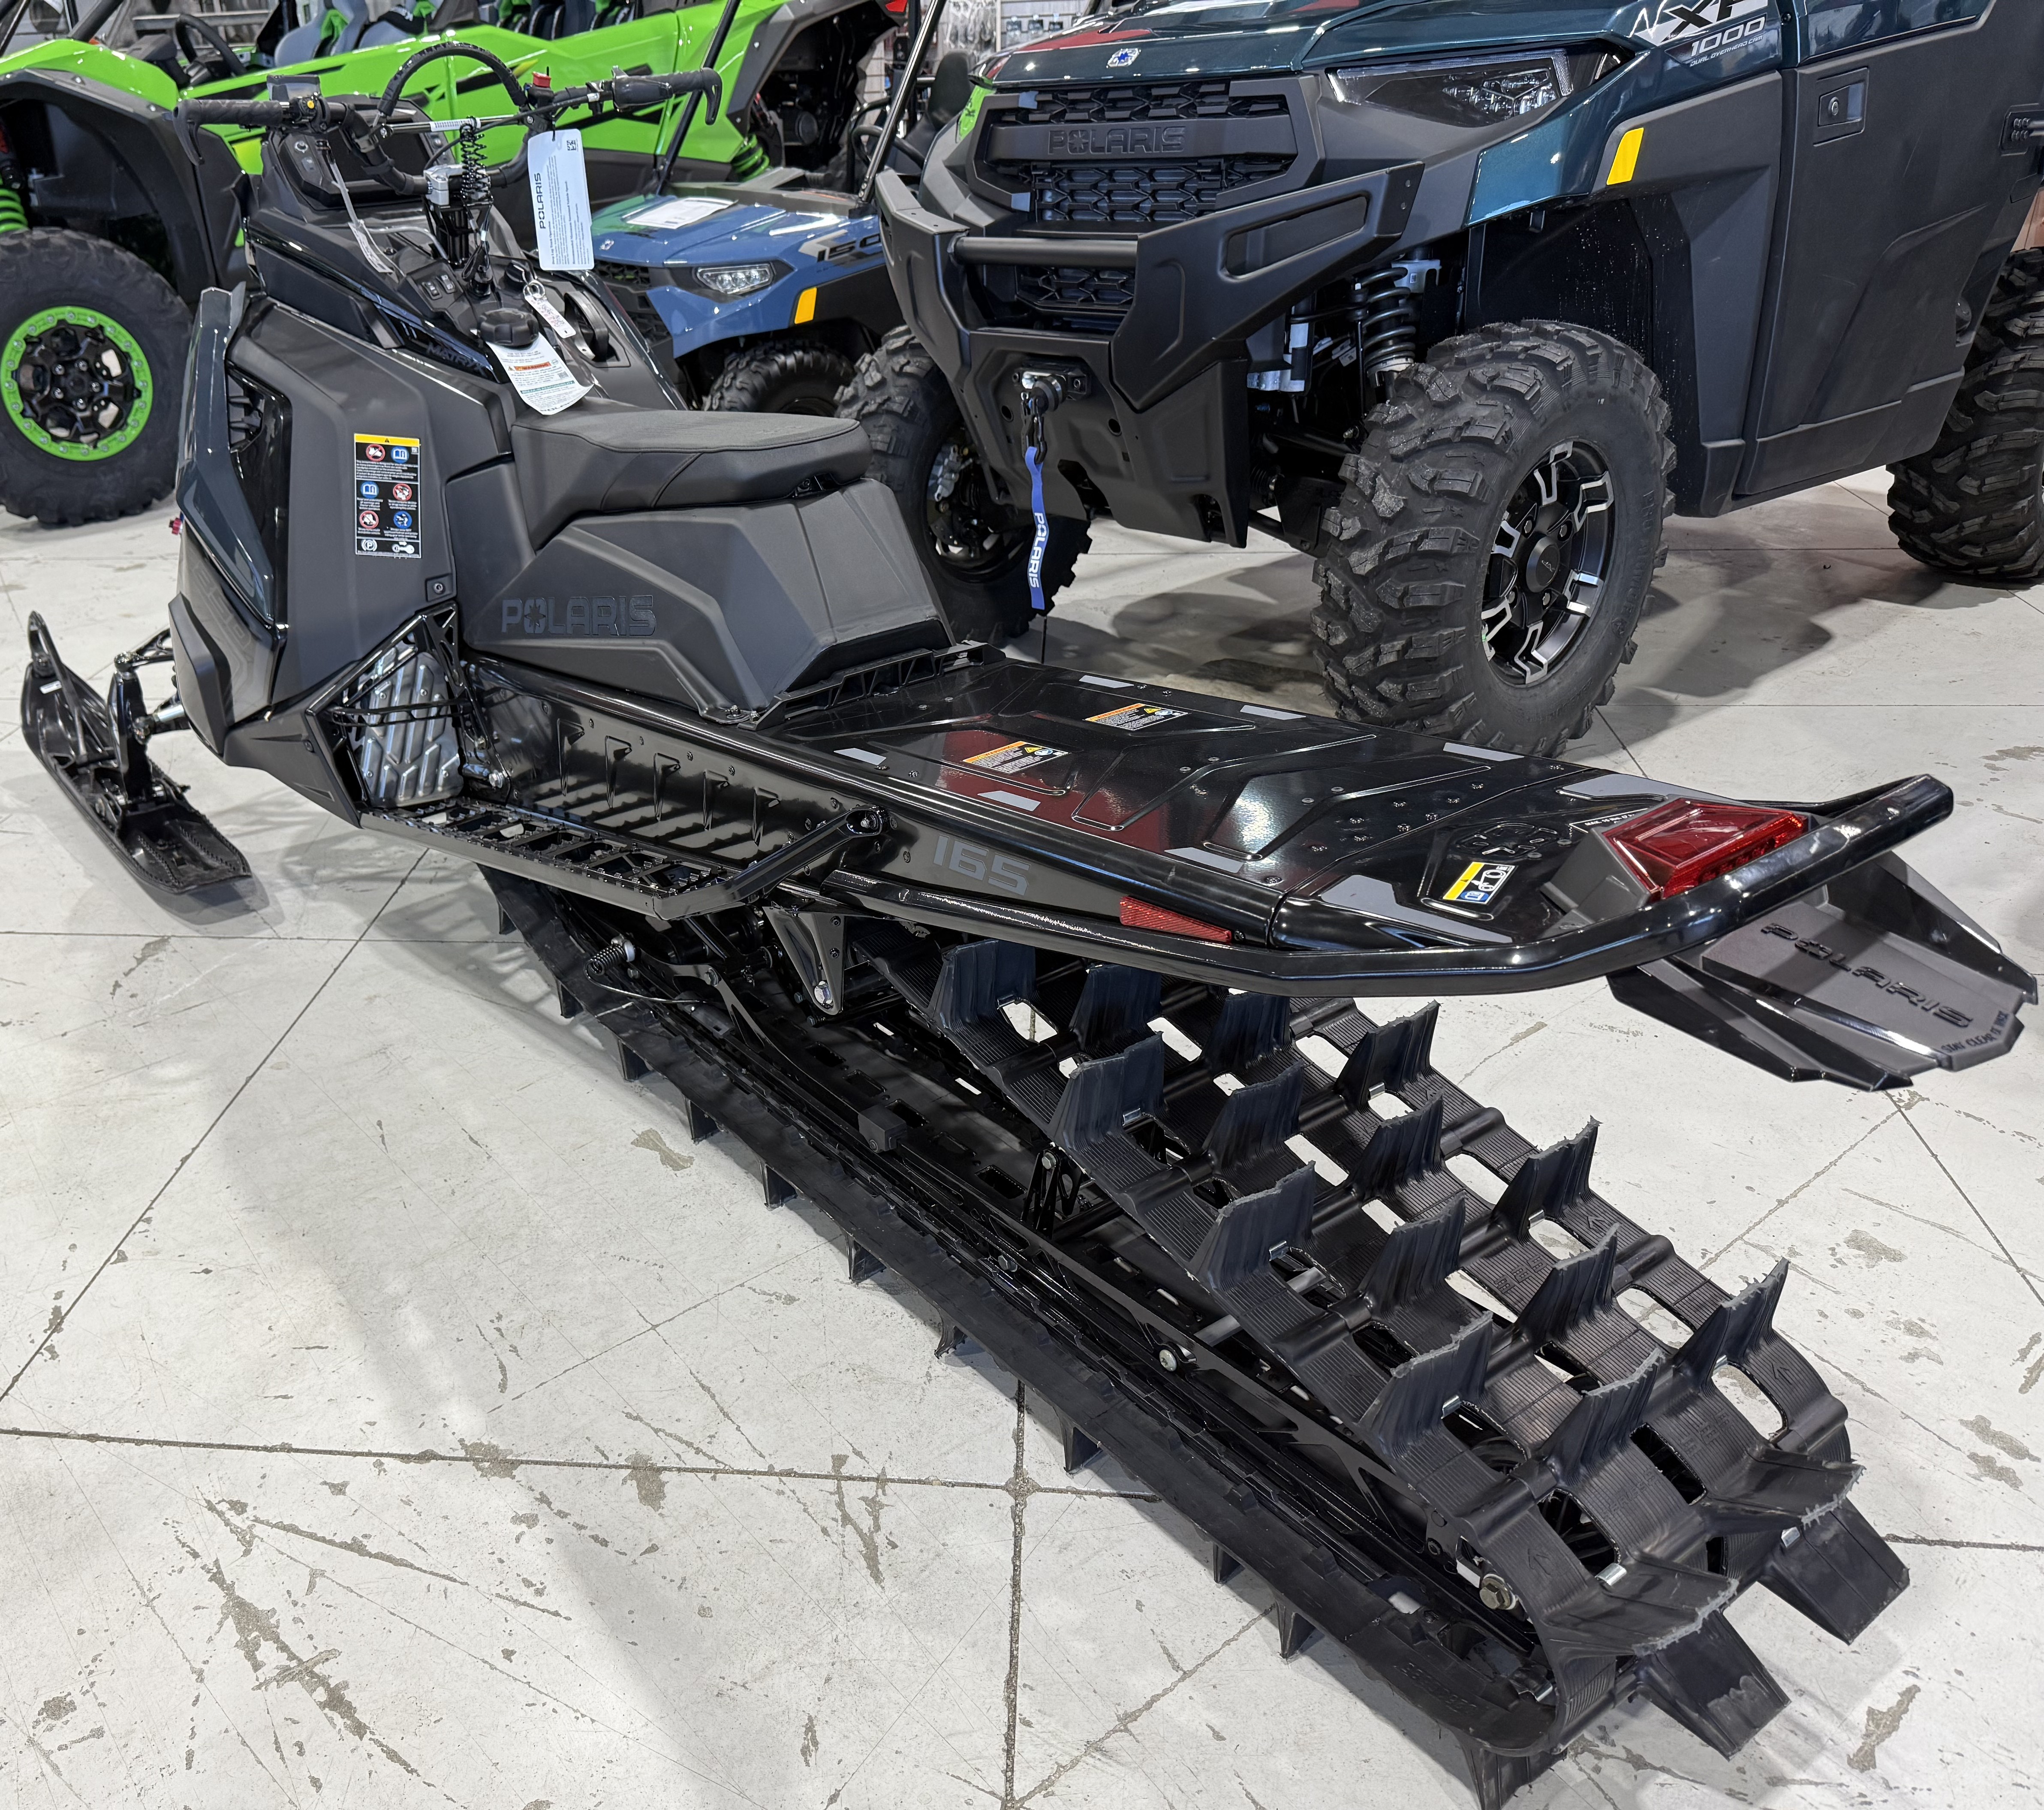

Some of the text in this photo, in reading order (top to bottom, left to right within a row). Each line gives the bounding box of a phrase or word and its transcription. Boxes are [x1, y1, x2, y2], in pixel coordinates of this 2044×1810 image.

[1690, 35, 1763, 67] DUAL OVERHEAD CAM
[1691, 16, 1766, 57] 1000
[1048, 126, 1186, 154] POLARIS
[534, 173, 545, 229] POLARIS
[427, 344, 488, 378] MATRYX
[1029, 512, 1047, 588] POLARIS
[501, 595, 657, 636] POLARIS
[933, 834, 1031, 896] 165
[1761, 922, 1973, 1028] POLARIS
[1941, 1042, 1966, 1052] STAY
[1966, 1033, 1997, 1047] CLEAR
